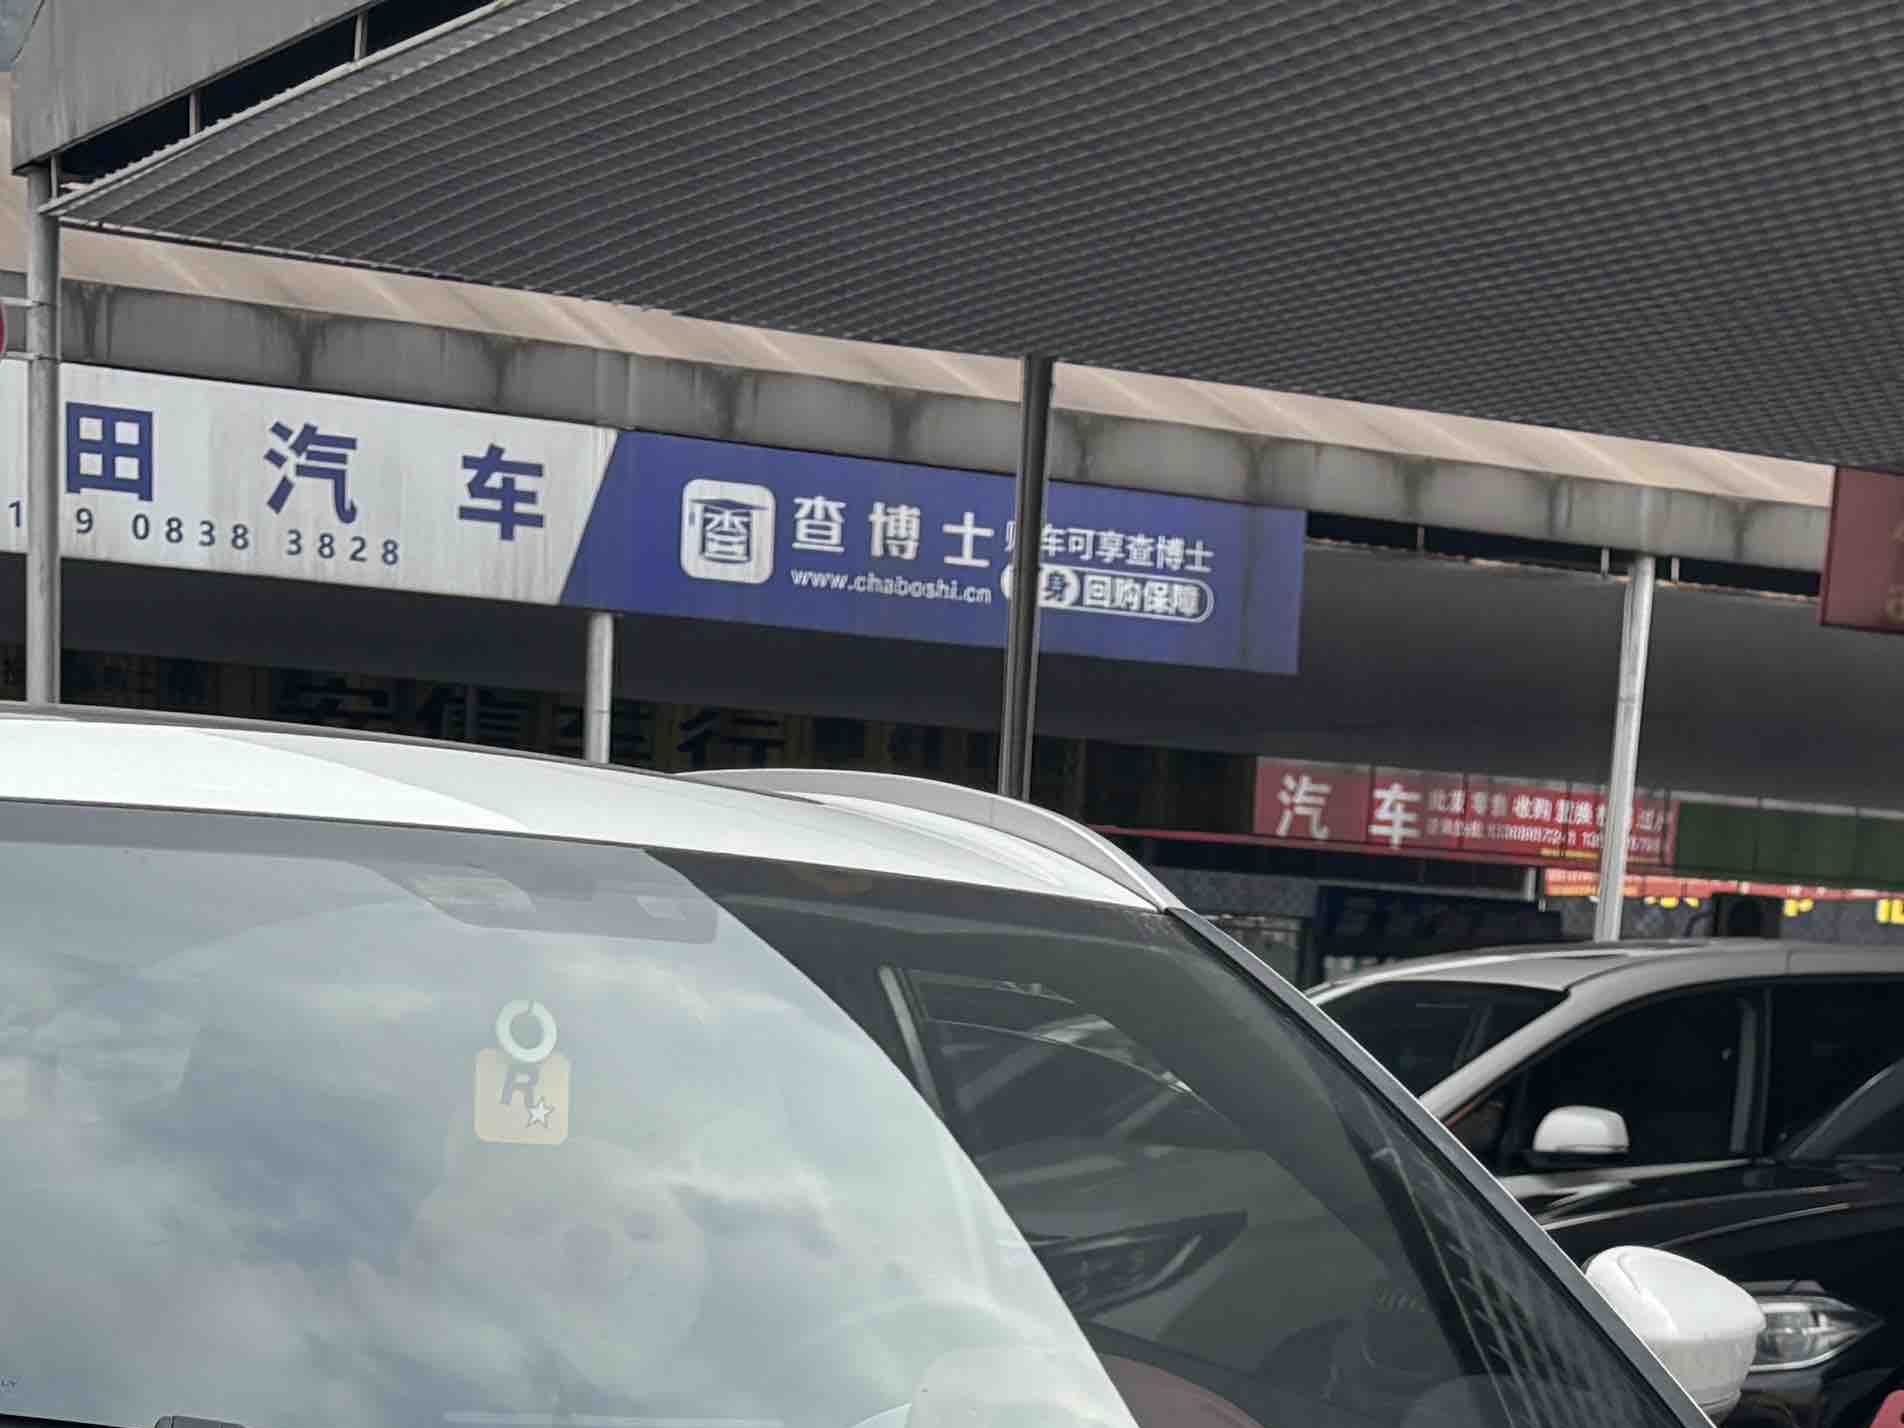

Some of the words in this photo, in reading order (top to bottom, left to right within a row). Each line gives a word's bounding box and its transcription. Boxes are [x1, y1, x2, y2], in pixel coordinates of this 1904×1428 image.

[8, 498, 94, 536] 19
[131, 512, 250, 552] 0838
[286, 529, 402, 567] 3828
[791, 495, 995, 569] 查博士
[790, 567, 993, 607] www.chaboshi.cn
[1276, 774, 1422, 850] 汽车
